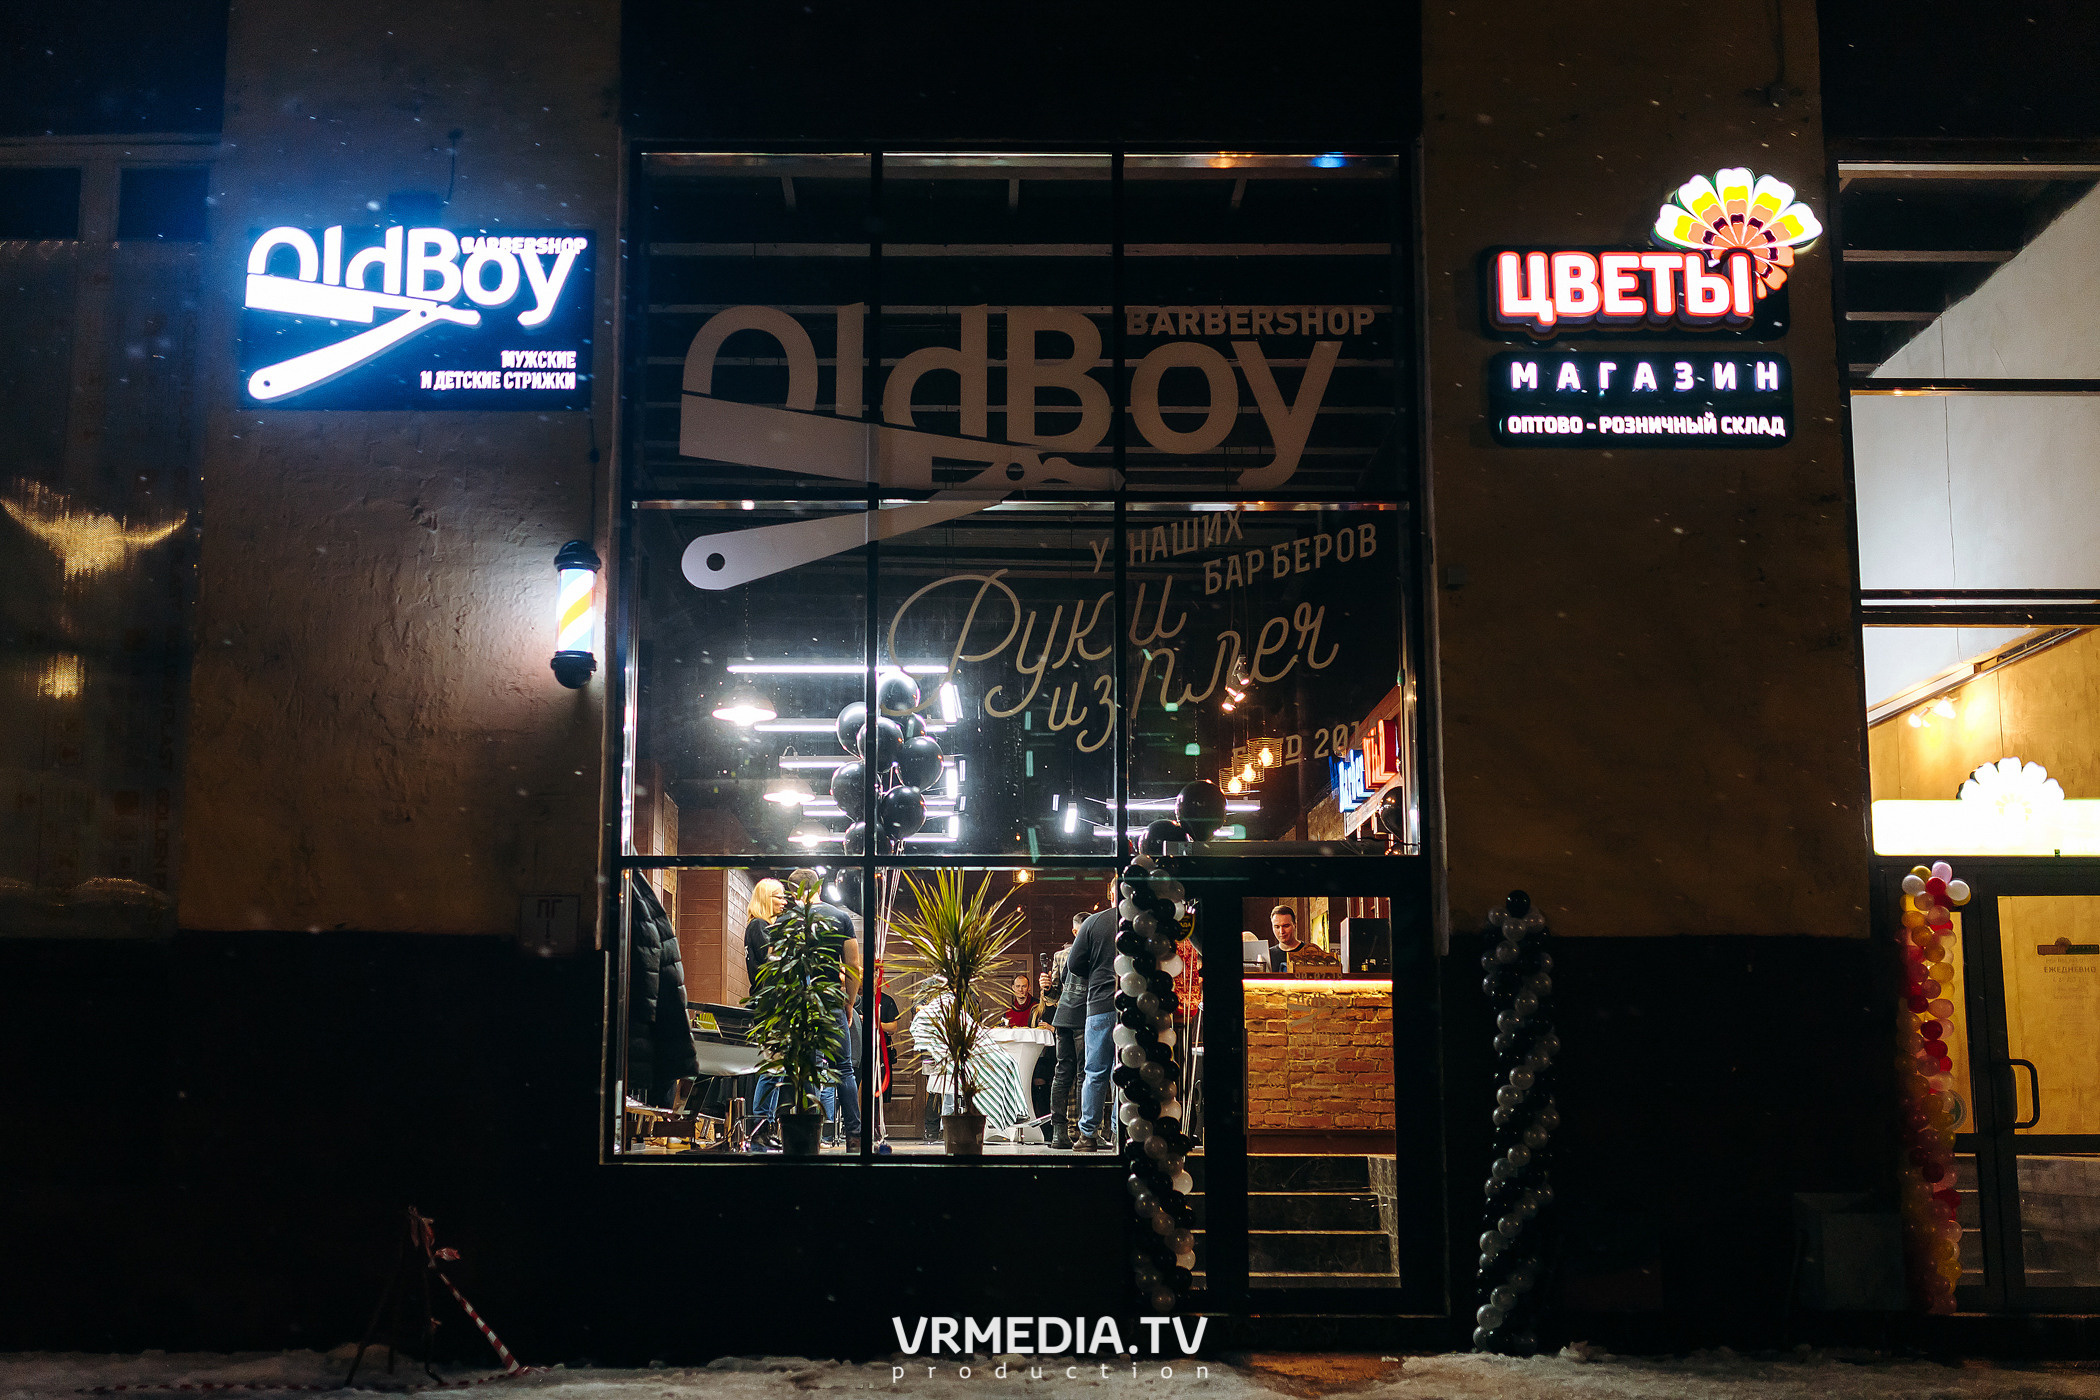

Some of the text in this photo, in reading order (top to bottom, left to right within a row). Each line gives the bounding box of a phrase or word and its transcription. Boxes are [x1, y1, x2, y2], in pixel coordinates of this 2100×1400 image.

[247, 225, 577, 326] OldBoy
[1498, 251, 1754, 325] ЦВЕТЫ
[1126, 307, 1375, 335] BARBERSHOP
[501, 350, 577, 369] МУЖСКИЕ
[420, 370, 576, 390] И ДЕТСКИЕ СТРИЖКИ
[1511, 361, 1779, 390] МАГАЗИН
[682, 302, 1343, 490] OldBoy
[1507, 415, 1583, 434] ОПТОВО
[1599, 411, 1718, 434] РОЗНИЧНЫЙ
[1720, 415, 1786, 437] СКЛАД
[1128, 510, 1243, 566] НАШИХ
[2044, 966, 2096, 974] ЕЖЕДНЕВНО
